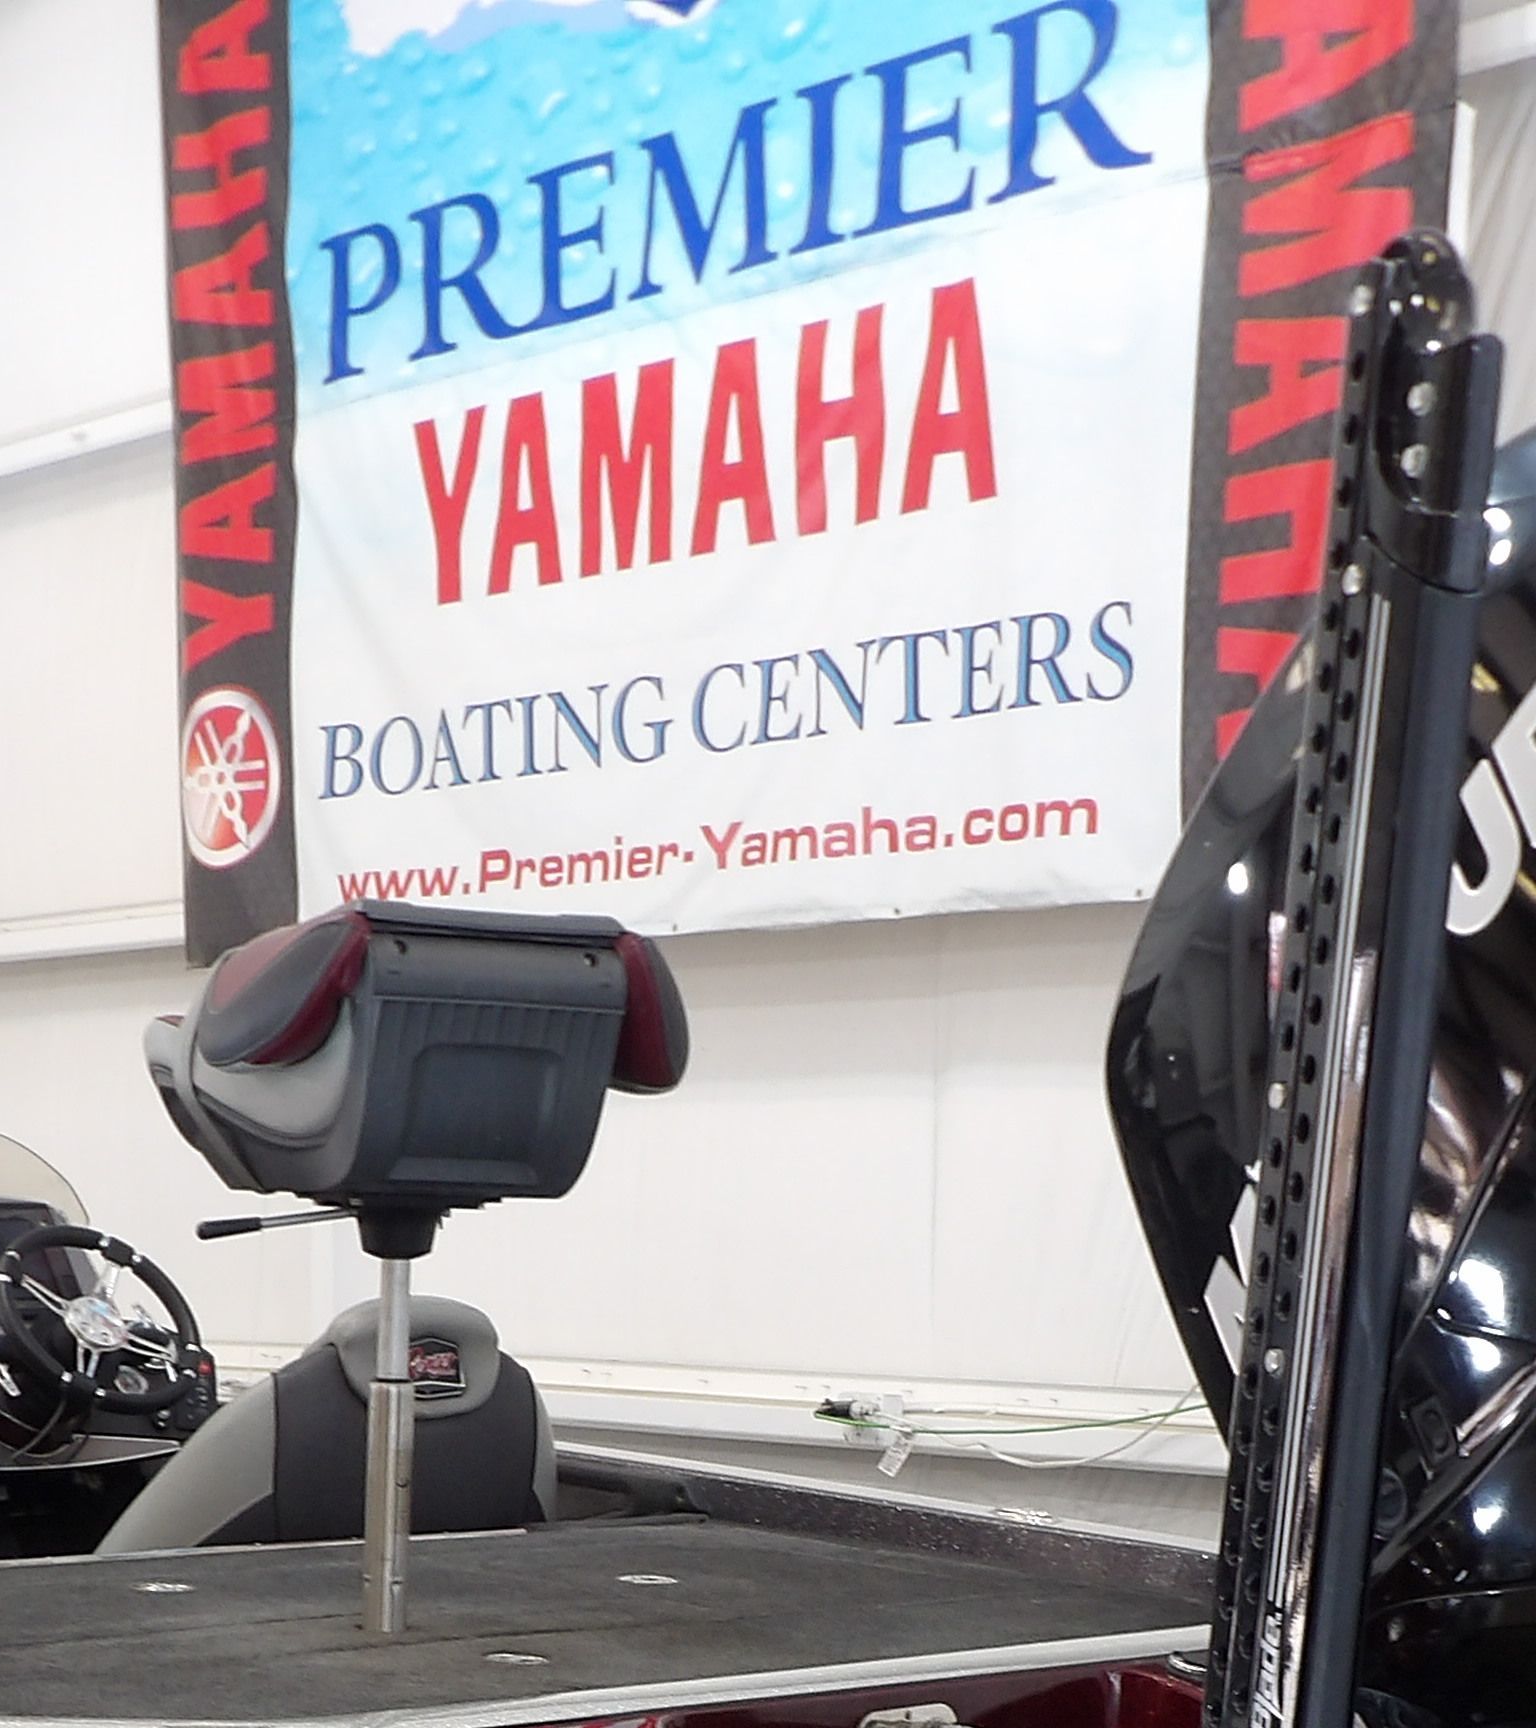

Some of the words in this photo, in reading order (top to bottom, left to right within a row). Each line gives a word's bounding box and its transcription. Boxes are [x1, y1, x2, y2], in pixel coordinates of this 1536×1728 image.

[173, 0, 276, 674] YAMAHA
[319, 0, 1153, 385] PREMIER
[413, 276, 998, 606] YAMAHA
[317, 675, 674, 800] BOATING
[692, 600, 1135, 754] CENTERS
[337, 797, 1099, 903] www.Premier-Yamaha.com
